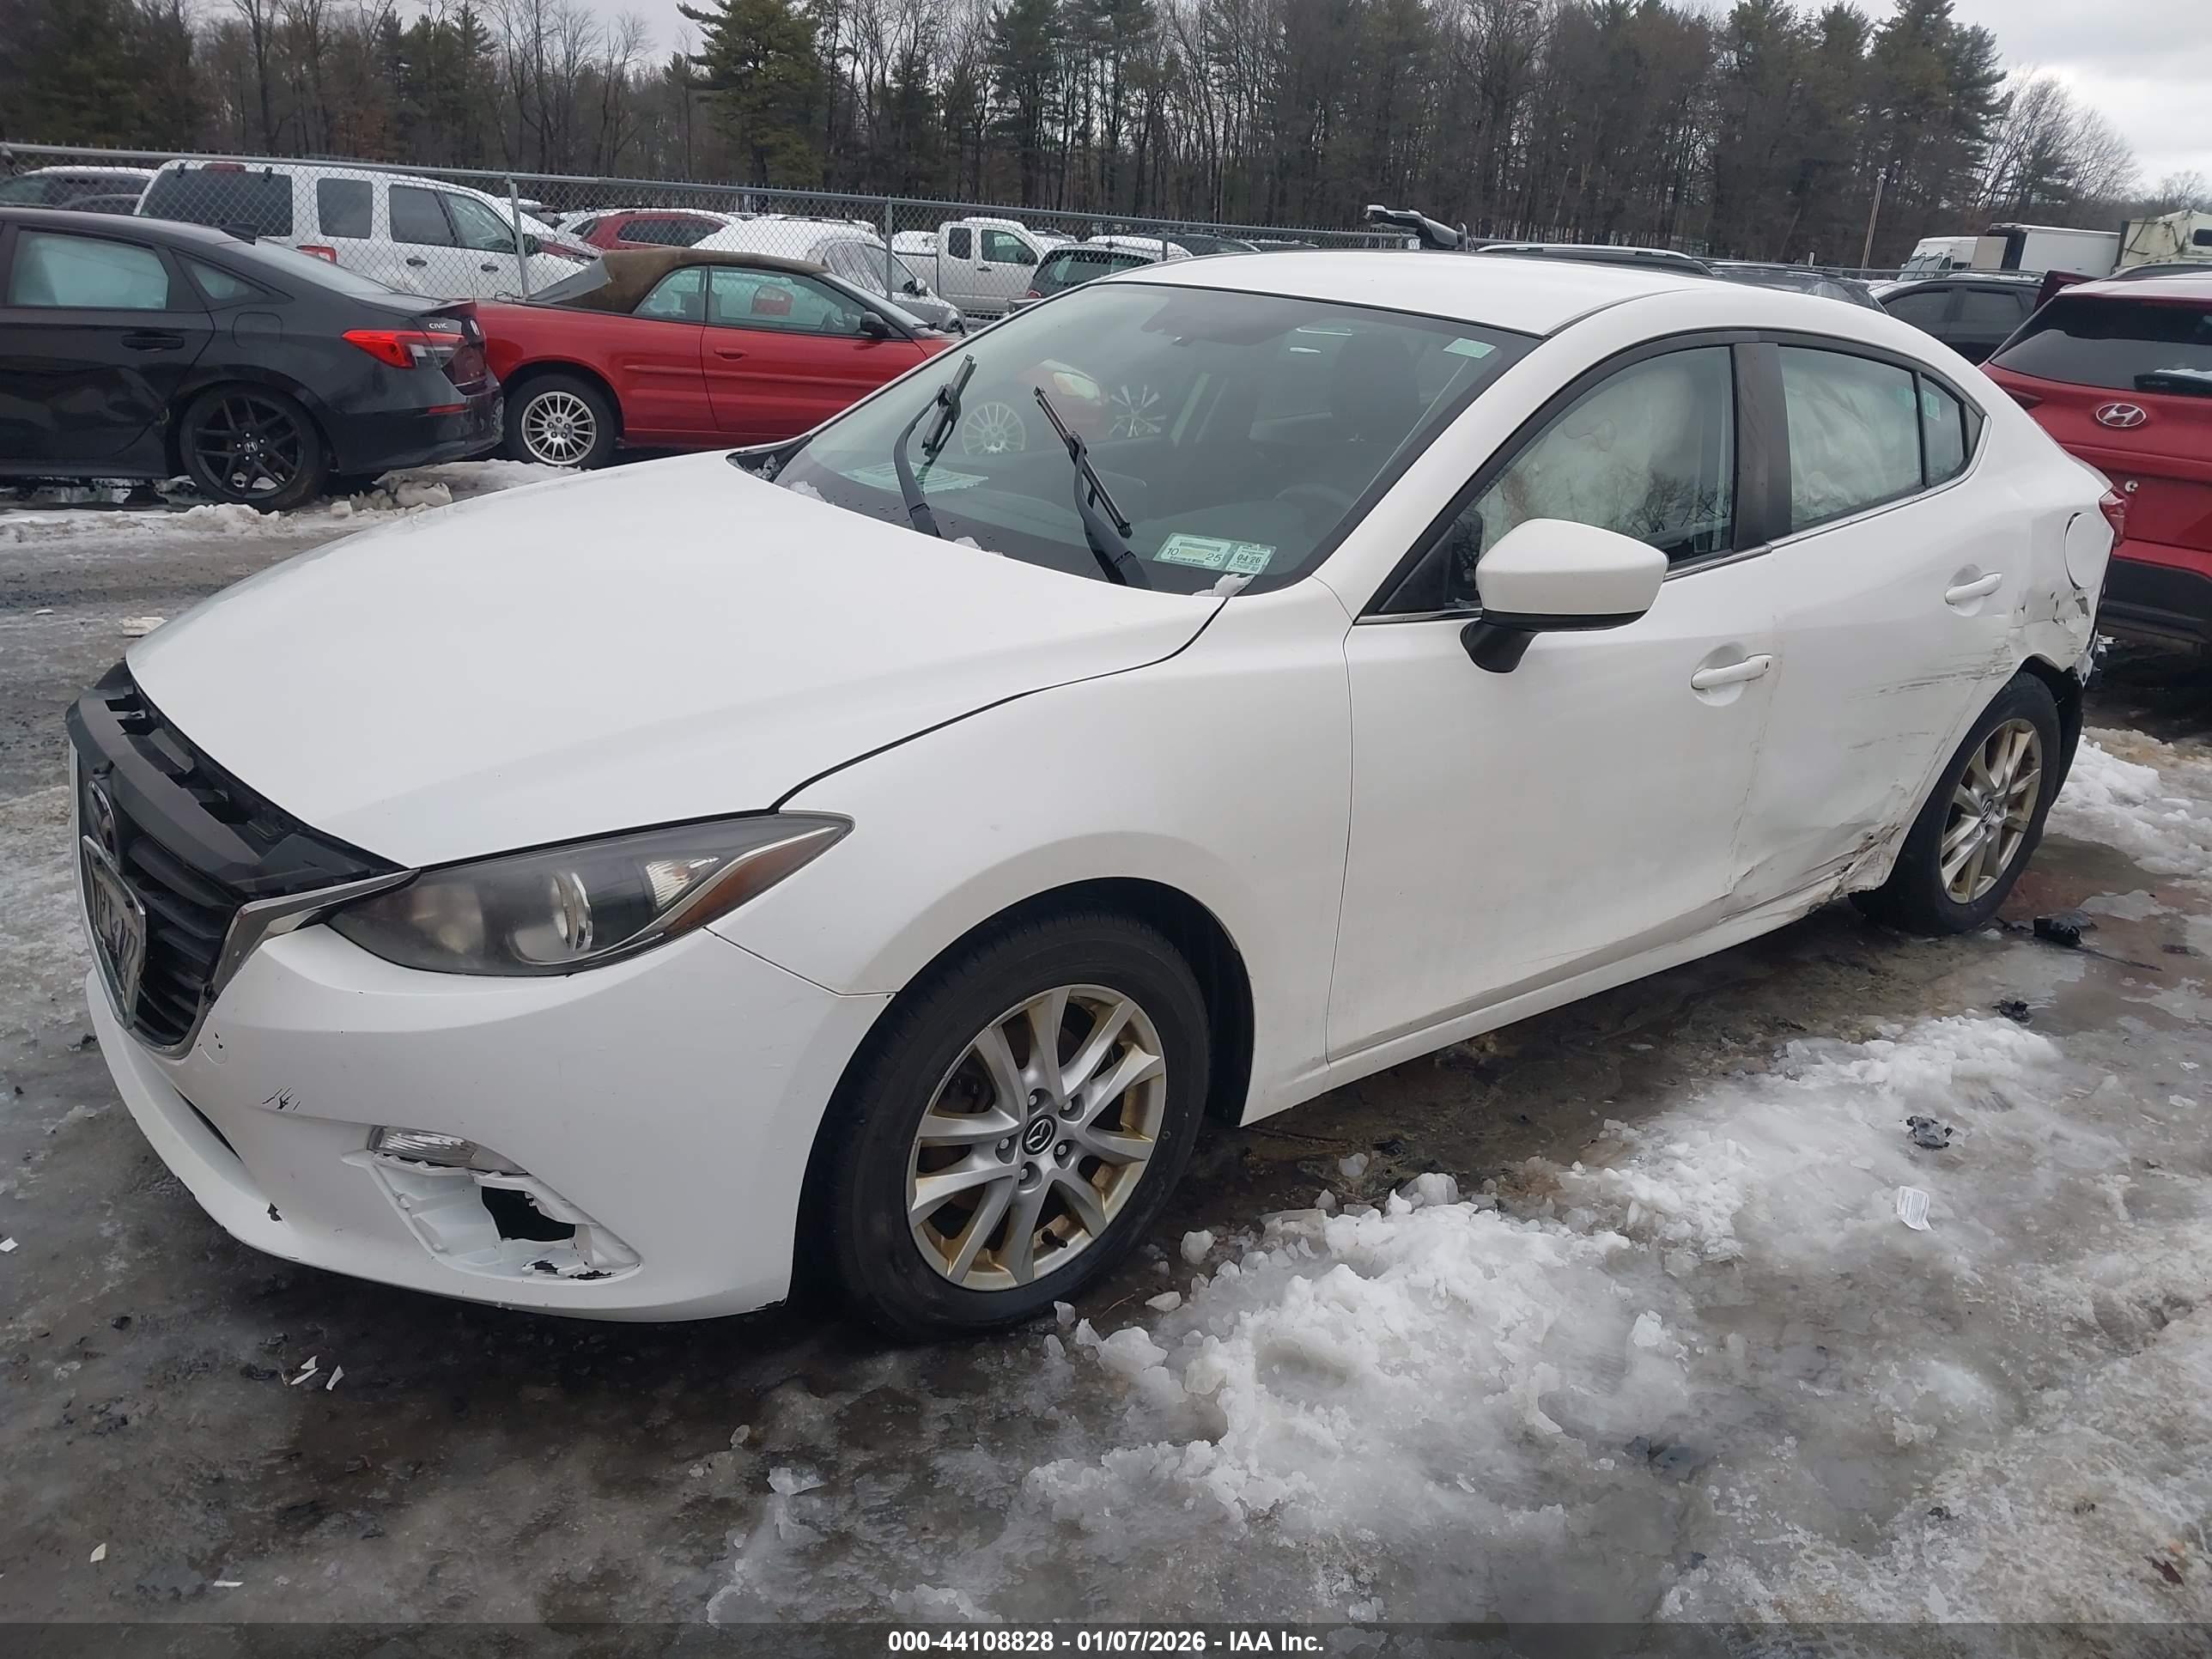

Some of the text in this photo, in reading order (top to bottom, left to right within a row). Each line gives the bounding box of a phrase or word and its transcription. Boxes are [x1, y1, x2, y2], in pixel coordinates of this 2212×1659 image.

[1167, 547, 1180, 556] 10
[1205, 552, 1223, 562] 25
[1249, 556, 1262, 564] 26
